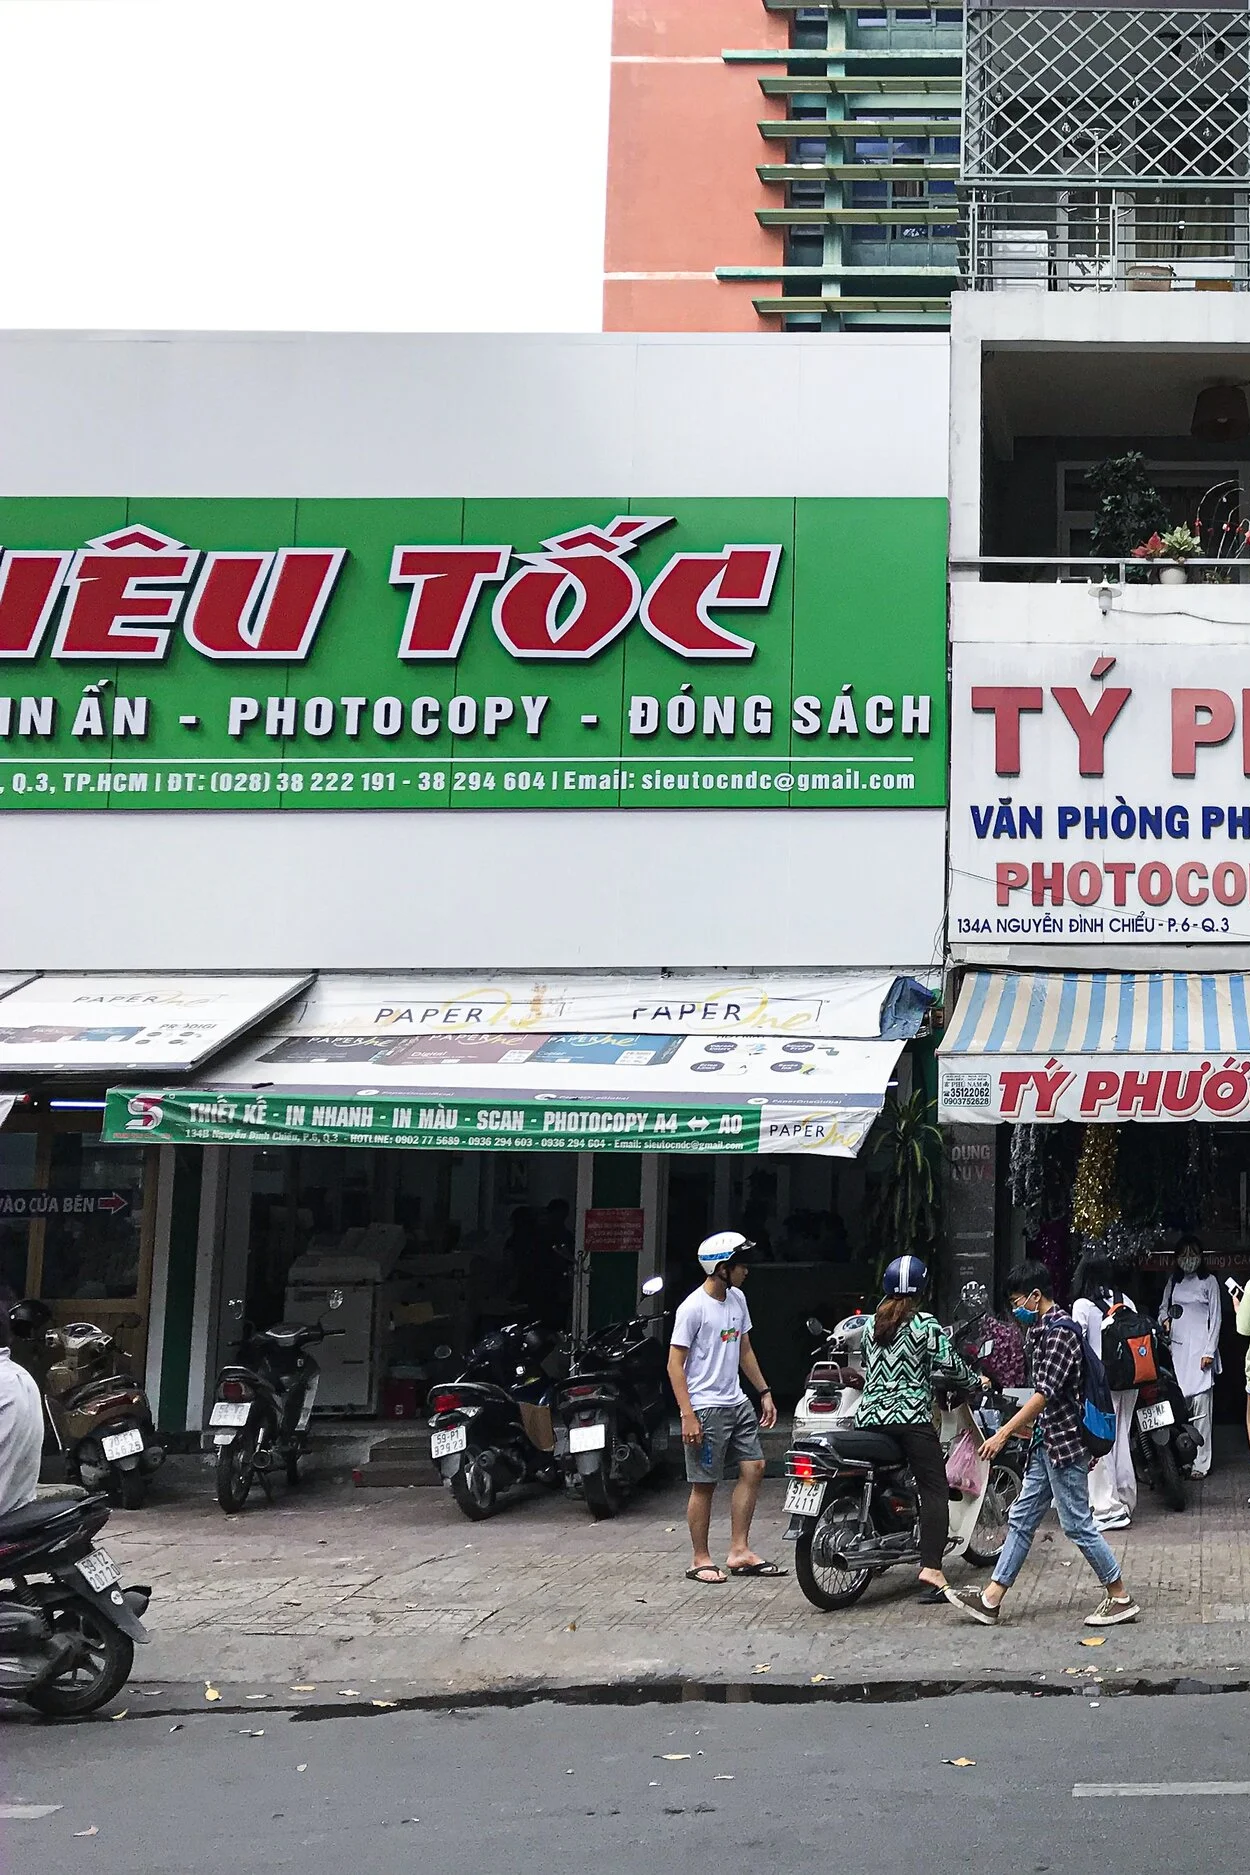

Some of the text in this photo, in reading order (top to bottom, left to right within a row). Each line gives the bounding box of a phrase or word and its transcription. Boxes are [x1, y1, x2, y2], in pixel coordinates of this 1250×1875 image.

[0, 515, 783, 659] IÊU TỐC
[71, 680, 149, 736] ẤN
[228, 695, 550, 737] PHOTOCOPY
[628, 684, 773, 735] ĐÓNG
[792, 684, 931, 735] SÁCH
[971, 656, 1133, 778] TÝ
[12, 768, 916, 794] Q.3, TP.HCM ĐT: (028) 38 222 191 38 294 604 Email: sieutocndc@gmail.com
[970, 797, 1043, 839] VĂN
[1058, 795, 1189, 839] PHÒNG
[957, 918, 992, 934] 134A
[996, 912, 1063, 934] NGUYỄN
[1069, 914, 1104, 933] ĐÌNH
[1109, 911, 1155, 933] CHIỂU
[1201, 917, 1230, 933] Q.3
[374, 1008, 483, 1024] PAPER
[950, 1087, 990, 1098] 35122062
[999, 1057, 1077, 1118] TÝ
[188, 1094, 238, 1124] THIẾT
[242, 1095, 268, 1125] KẾ
[285, 1105, 306, 1126] IN
[311, 1105, 374, 1128] NHANH
[392, 1107, 412, 1129] IN
[418, 1103, 458, 1130] MÀU
[476, 1110, 525, 1131] SCAN
[543, 1111, 648, 1133] PHOTOCOPY
[653, 1113, 678, 1134] A4
[350, 1133, 393, 1144] HOTLINE:
[395, 1134, 419, 1145] 0902
[421, 1134, 433, 1144] 77
[436, 1135, 460, 1146] 5689
[468, 1136, 492, 1146] 0936
[494, 1137, 512, 1147] 294
[514, 1138, 533, 1147] 603
[541, 1138, 565, 1147] 0936
[567, 1139, 585, 1148] 294
[614, 1140, 641, 1149] Email:
[769, 1124, 825, 1138] PAPER
[788, 1497, 816, 1512] 7411
